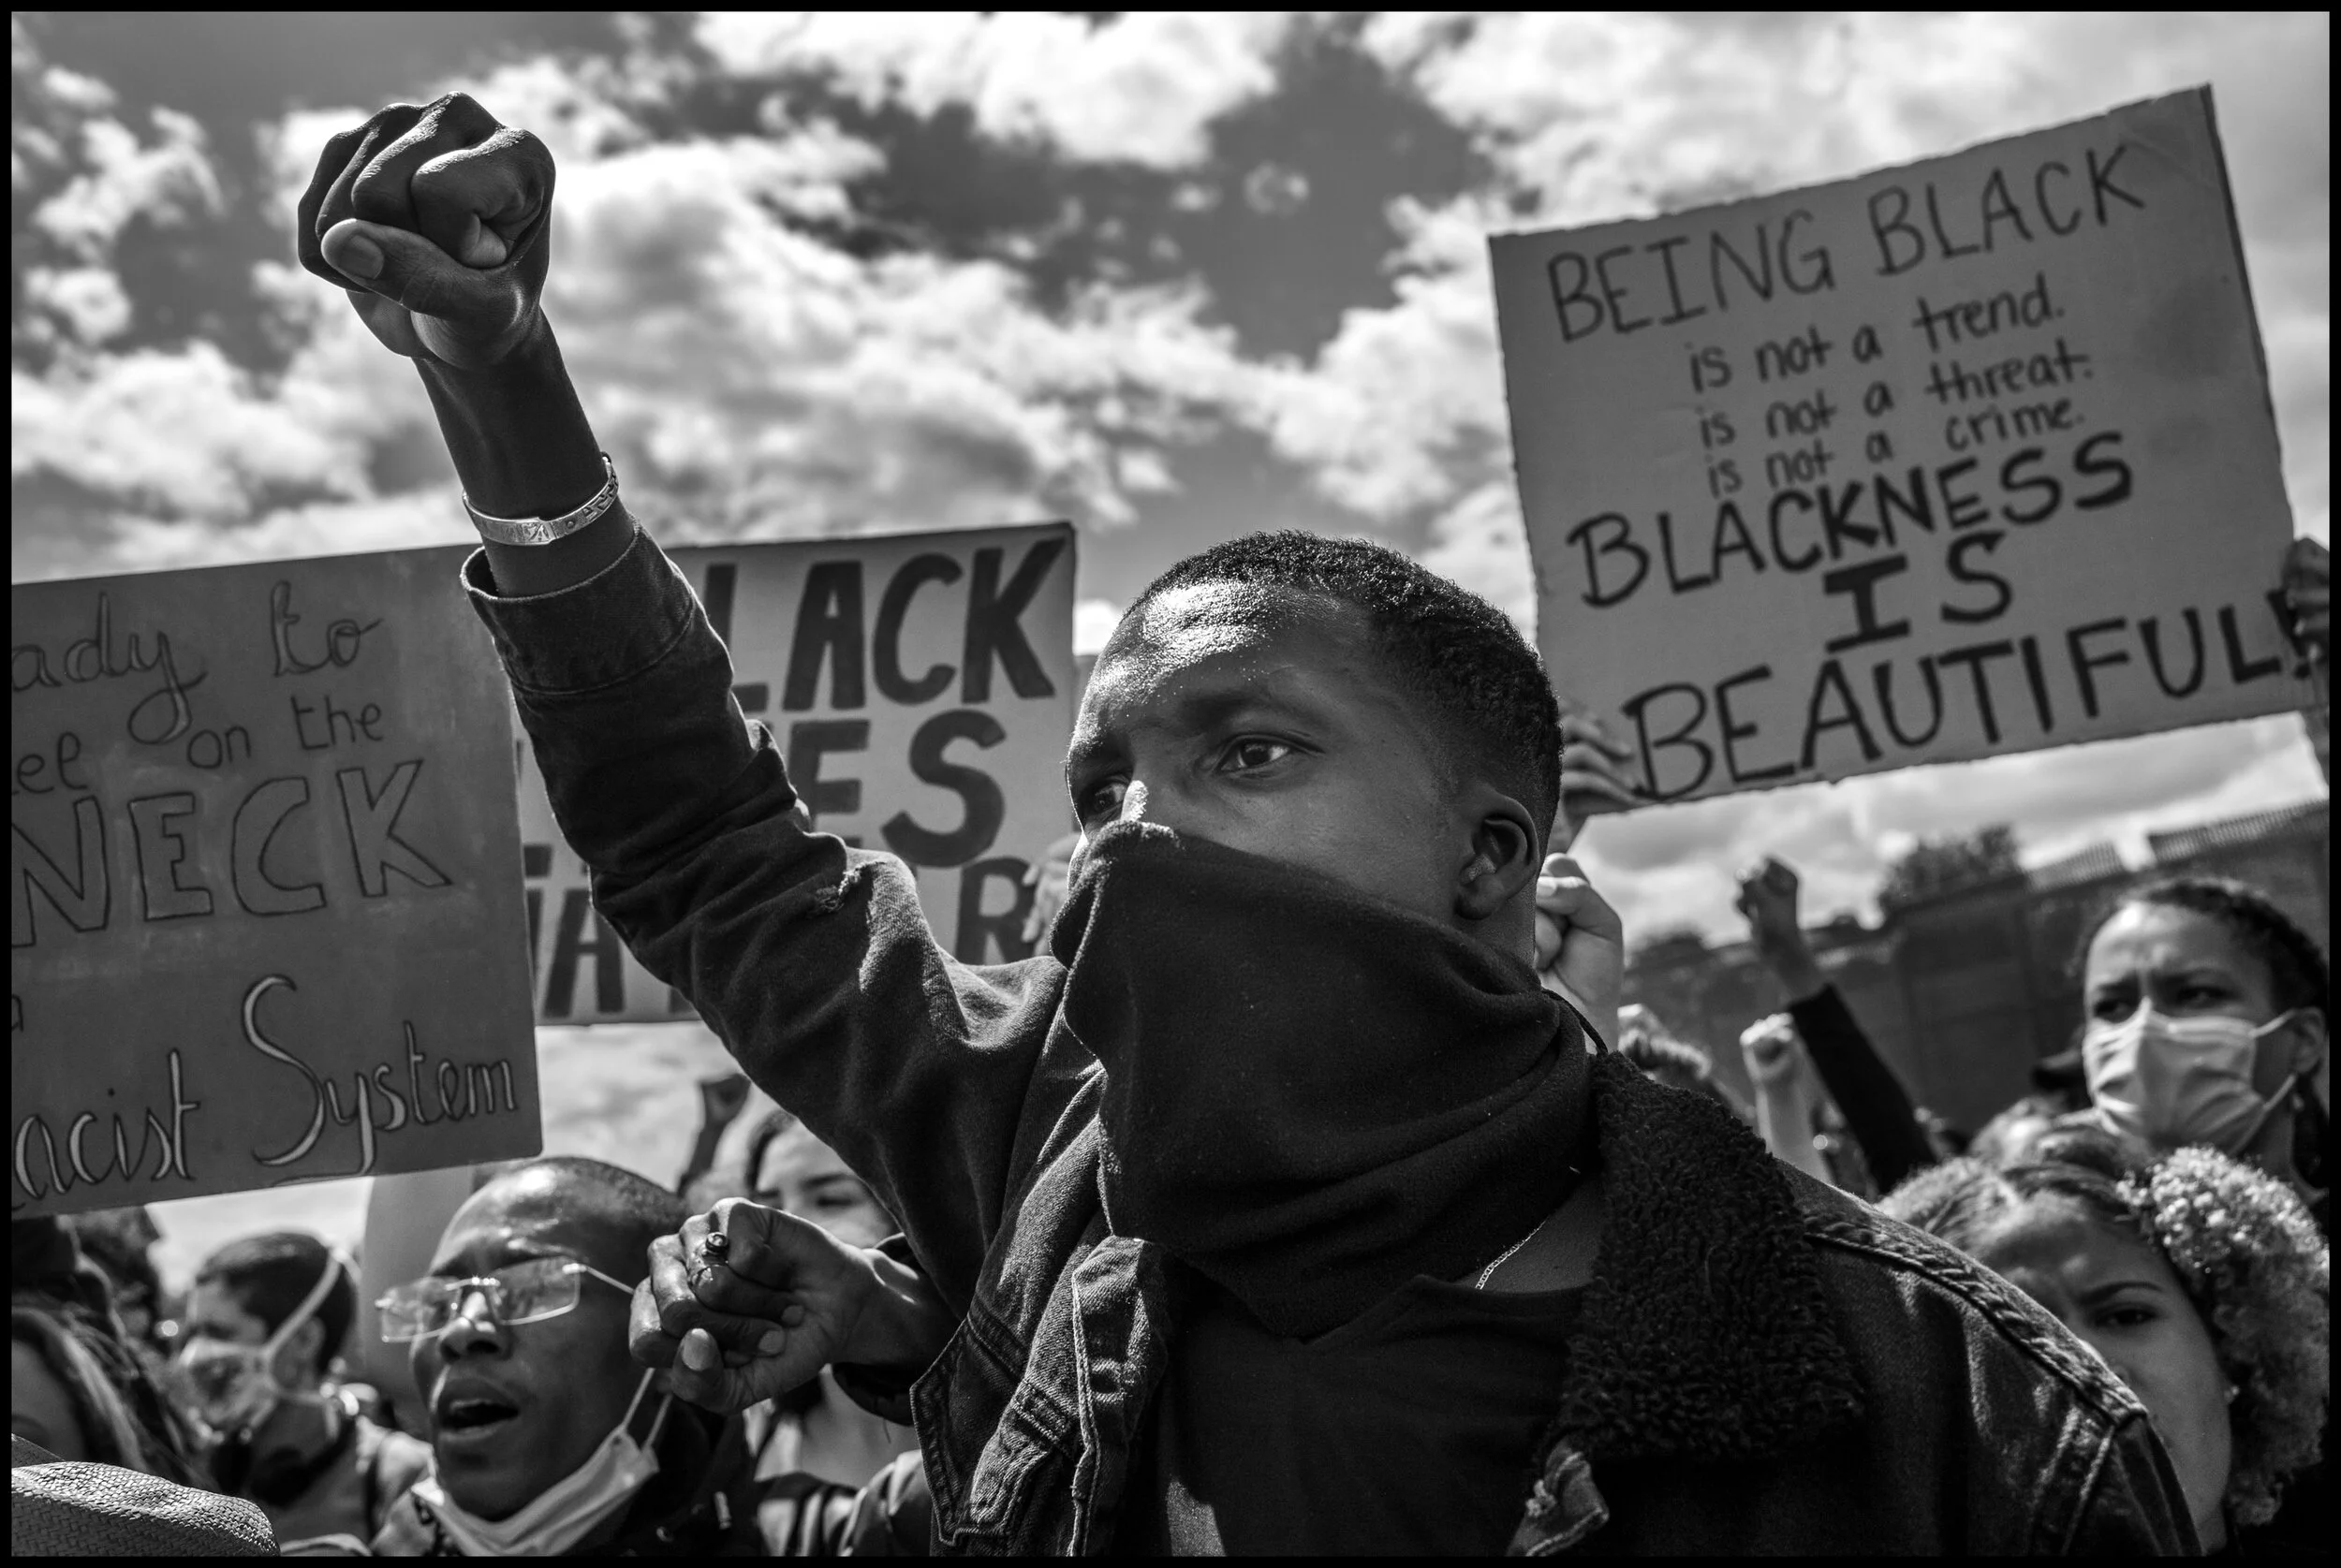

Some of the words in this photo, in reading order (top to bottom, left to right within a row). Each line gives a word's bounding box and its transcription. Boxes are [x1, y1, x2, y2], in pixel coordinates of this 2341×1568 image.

[1545, 208, 1836, 343] BEING
[1868, 142, 2146, 278] BLACK
[1686, 341, 1733, 394] is
[1754, 323, 1834, 383] not
[1851, 323, 1883, 364] a
[1911, 270, 2066, 354] trend.
[1695, 404, 1736, 449] is
[1765, 388, 1838, 439] not
[1863, 380, 1895, 418] a
[1924, 337, 2091, 405] threat.
[1566, 431, 2134, 609] BLACKNESS
[1703, 453, 1744, 499] is
[1765, 437, 1835, 490] not
[1866, 430, 1894, 464] a
[1945, 396, 2085, 453] crime.
[11, 592, 209, 745] ady
[269, 579, 385, 678] to
[1822, 530, 2014, 654] IS
[11, 731, 89, 795] ee
[188, 725, 251, 769] on
[290, 695, 385, 750] the
[1621, 587, 2311, 802] BEAUTIFUL!
[11, 758, 453, 947] NECK
[760, 708, 1007, 868] ES
[11, 1048, 201, 1211] acist
[240, 974, 518, 1186] System
